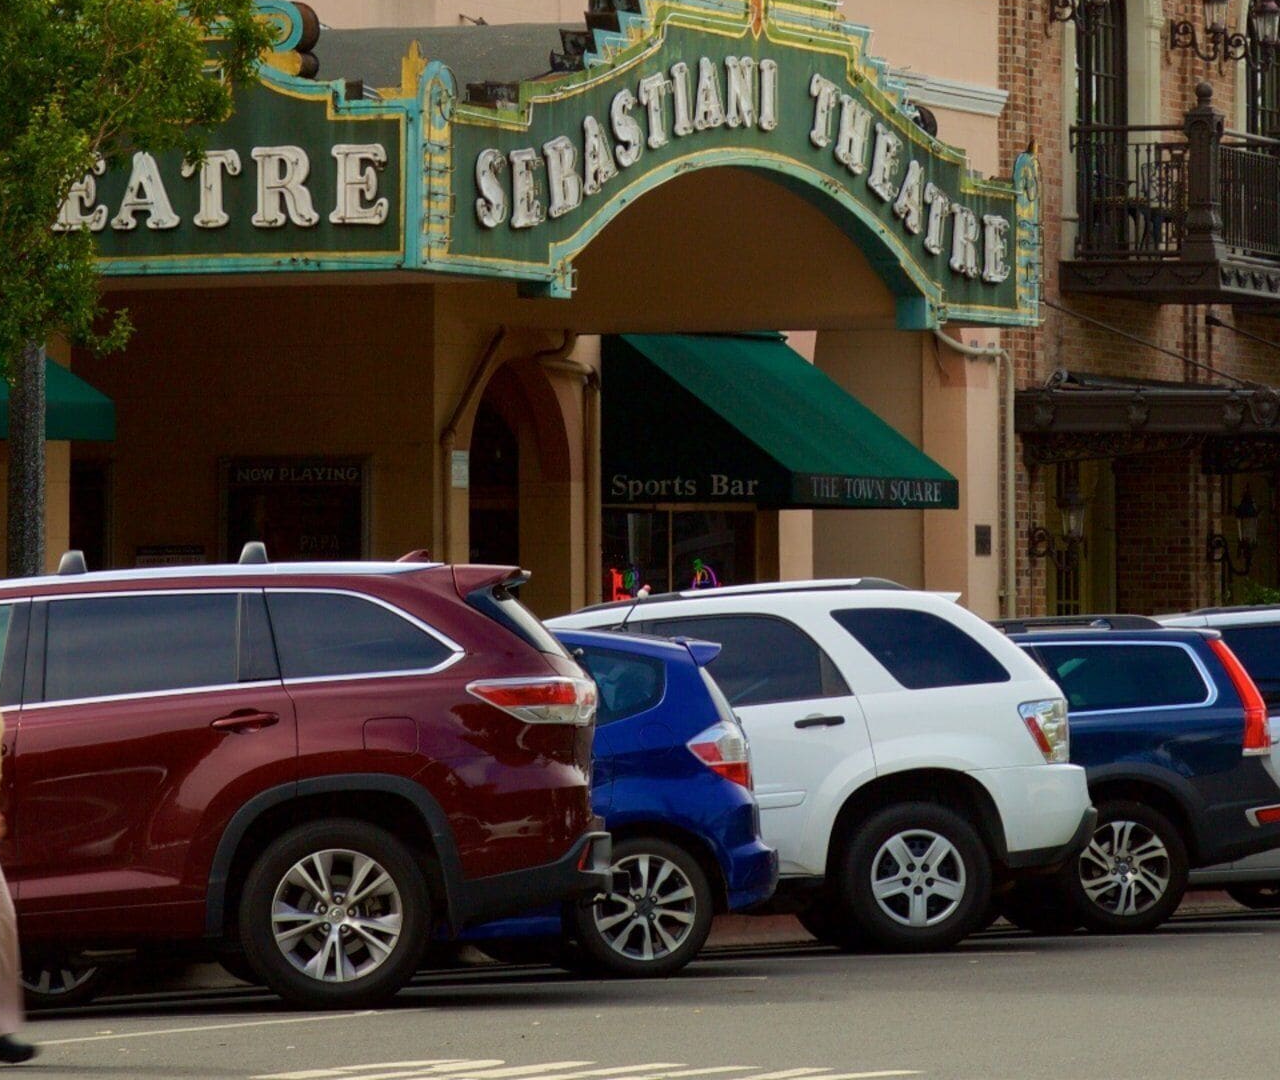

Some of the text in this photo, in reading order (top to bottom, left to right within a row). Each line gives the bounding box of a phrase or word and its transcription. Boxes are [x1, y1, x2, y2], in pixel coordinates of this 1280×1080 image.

[474, 56, 1011, 284] SEBASTIANI THEATRE
[51, 143, 389, 232] EATRE
[238, 466, 361, 481] NOW PLAYING
[611, 473, 759, 499] Sports Bar
[810, 476, 942, 506] THE TOWN SQUARE
